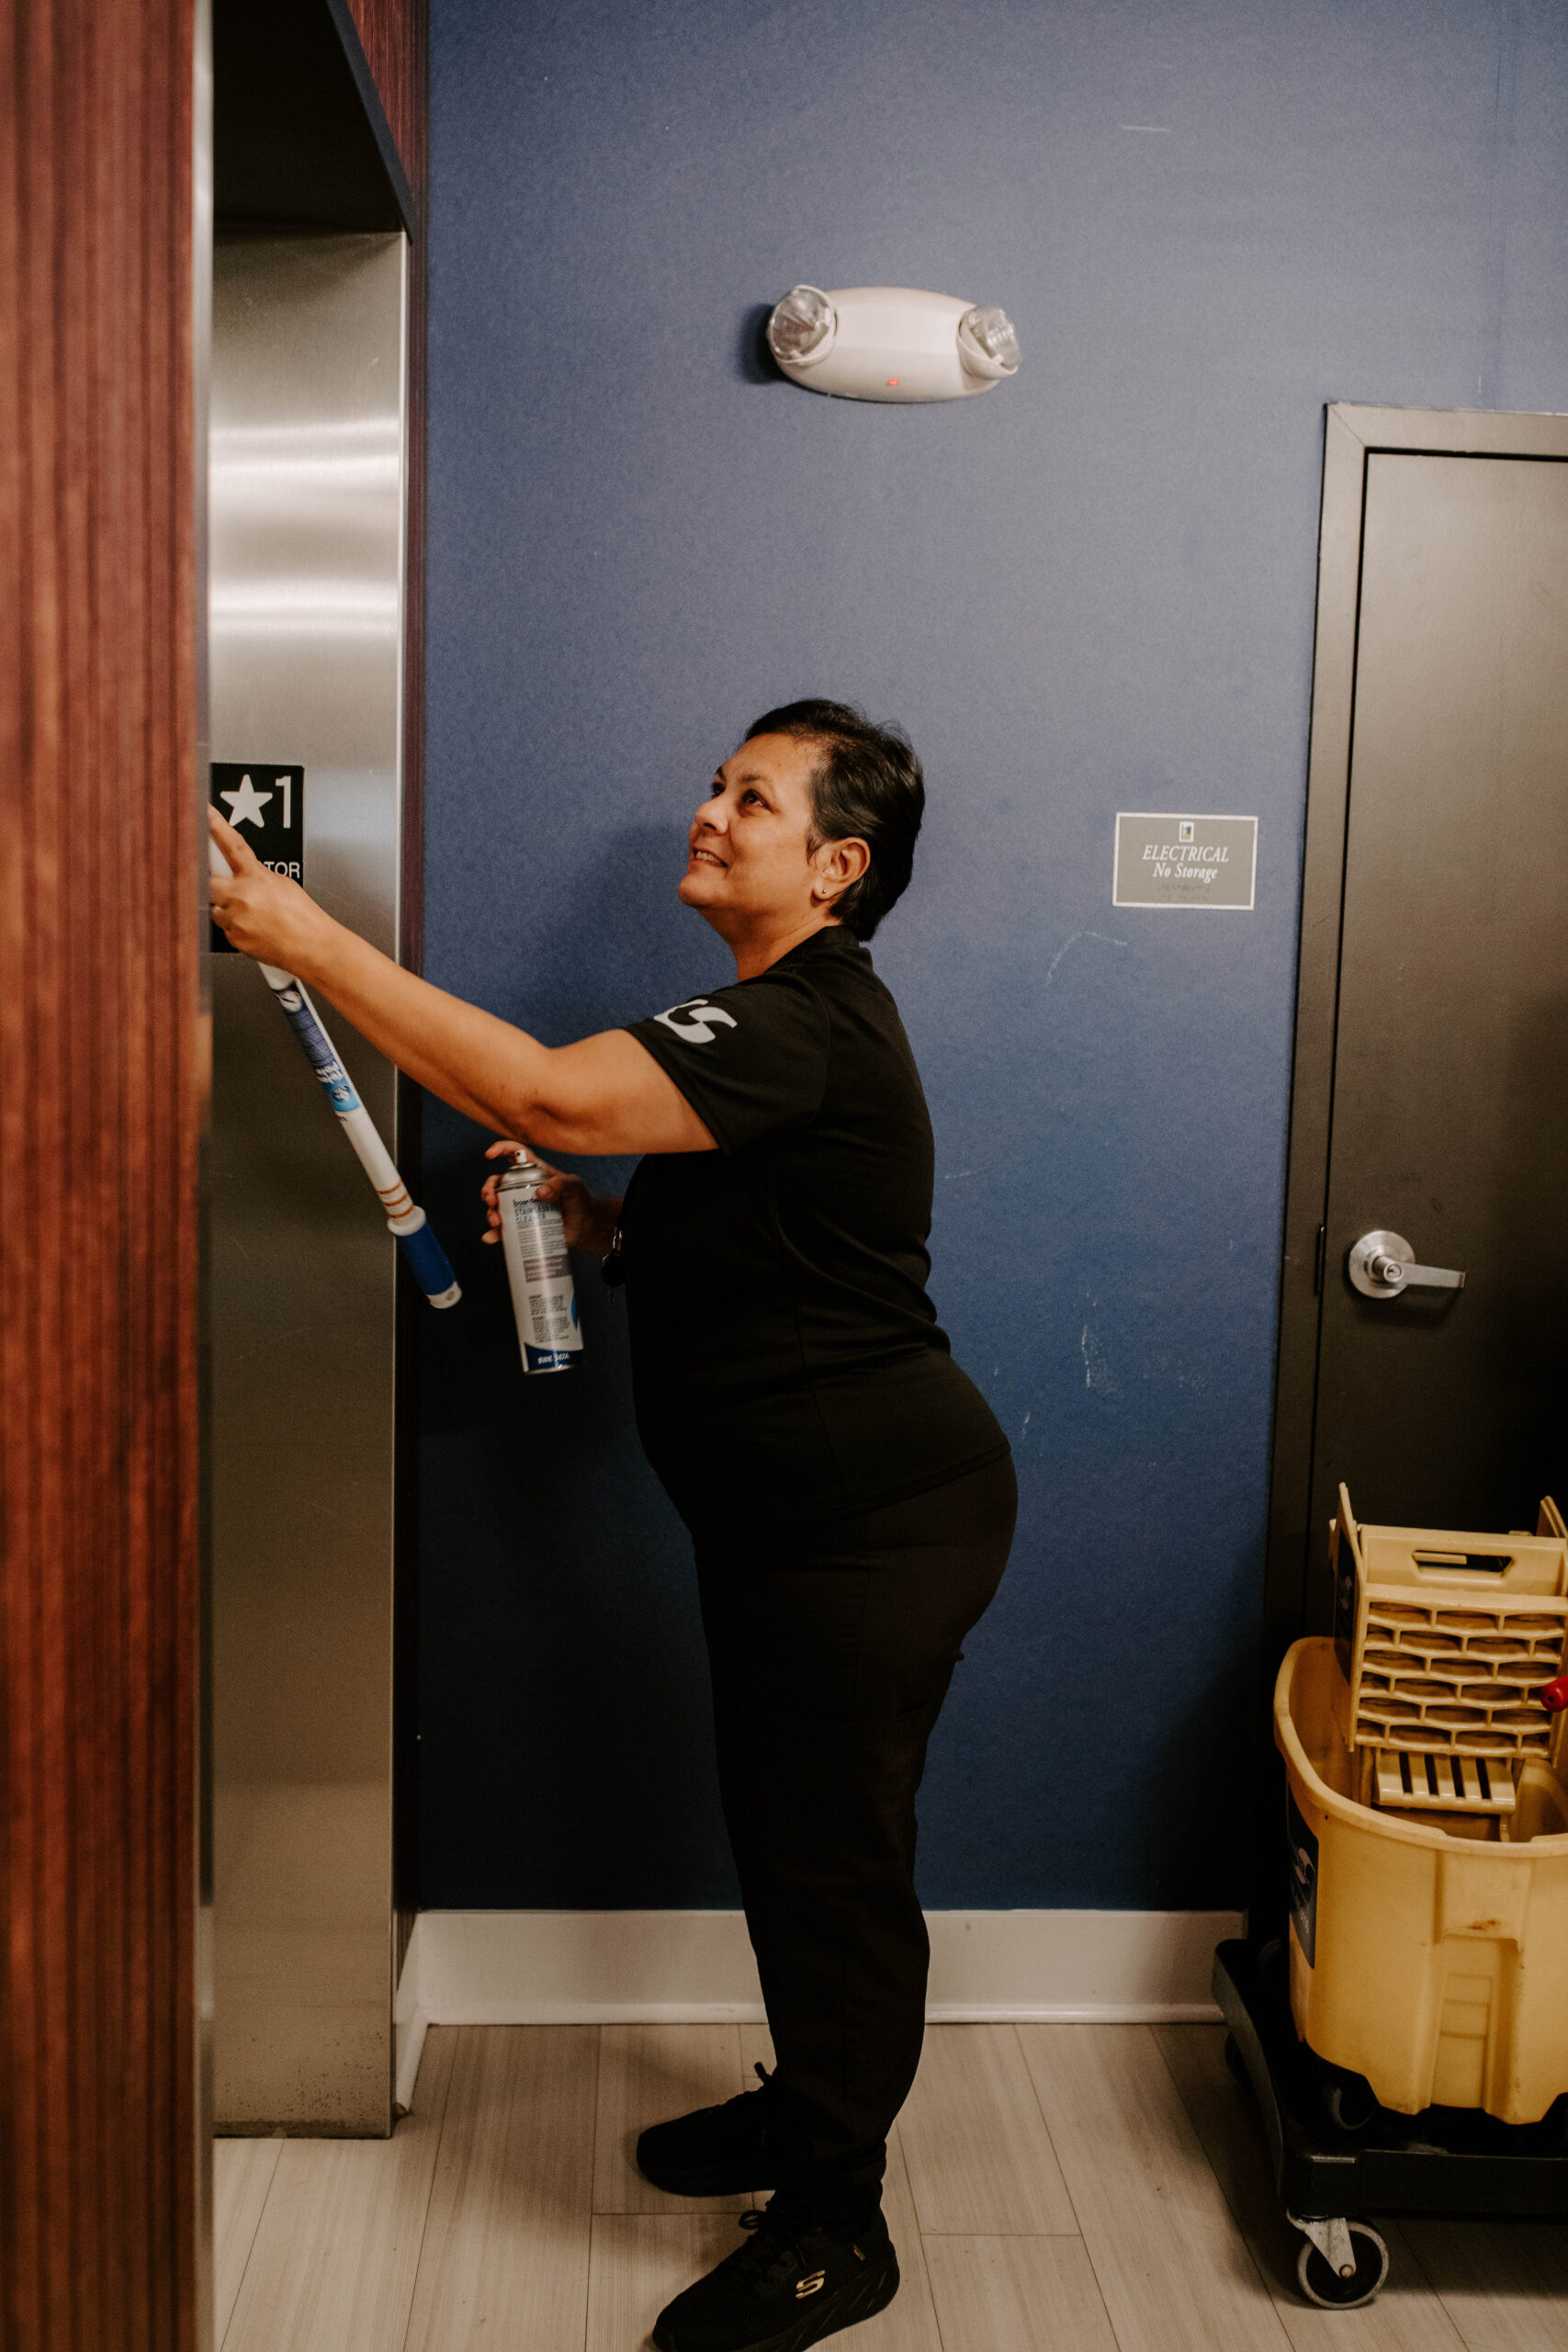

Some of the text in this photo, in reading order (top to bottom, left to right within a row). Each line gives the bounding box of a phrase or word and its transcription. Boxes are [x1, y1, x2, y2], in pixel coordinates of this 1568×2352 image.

[276, 775, 291, 829] 1
[1142, 844, 1229, 862] ELECTRICAL
[1152, 862, 1219, 884] No Storage
[795, 2269, 826, 2300] S
